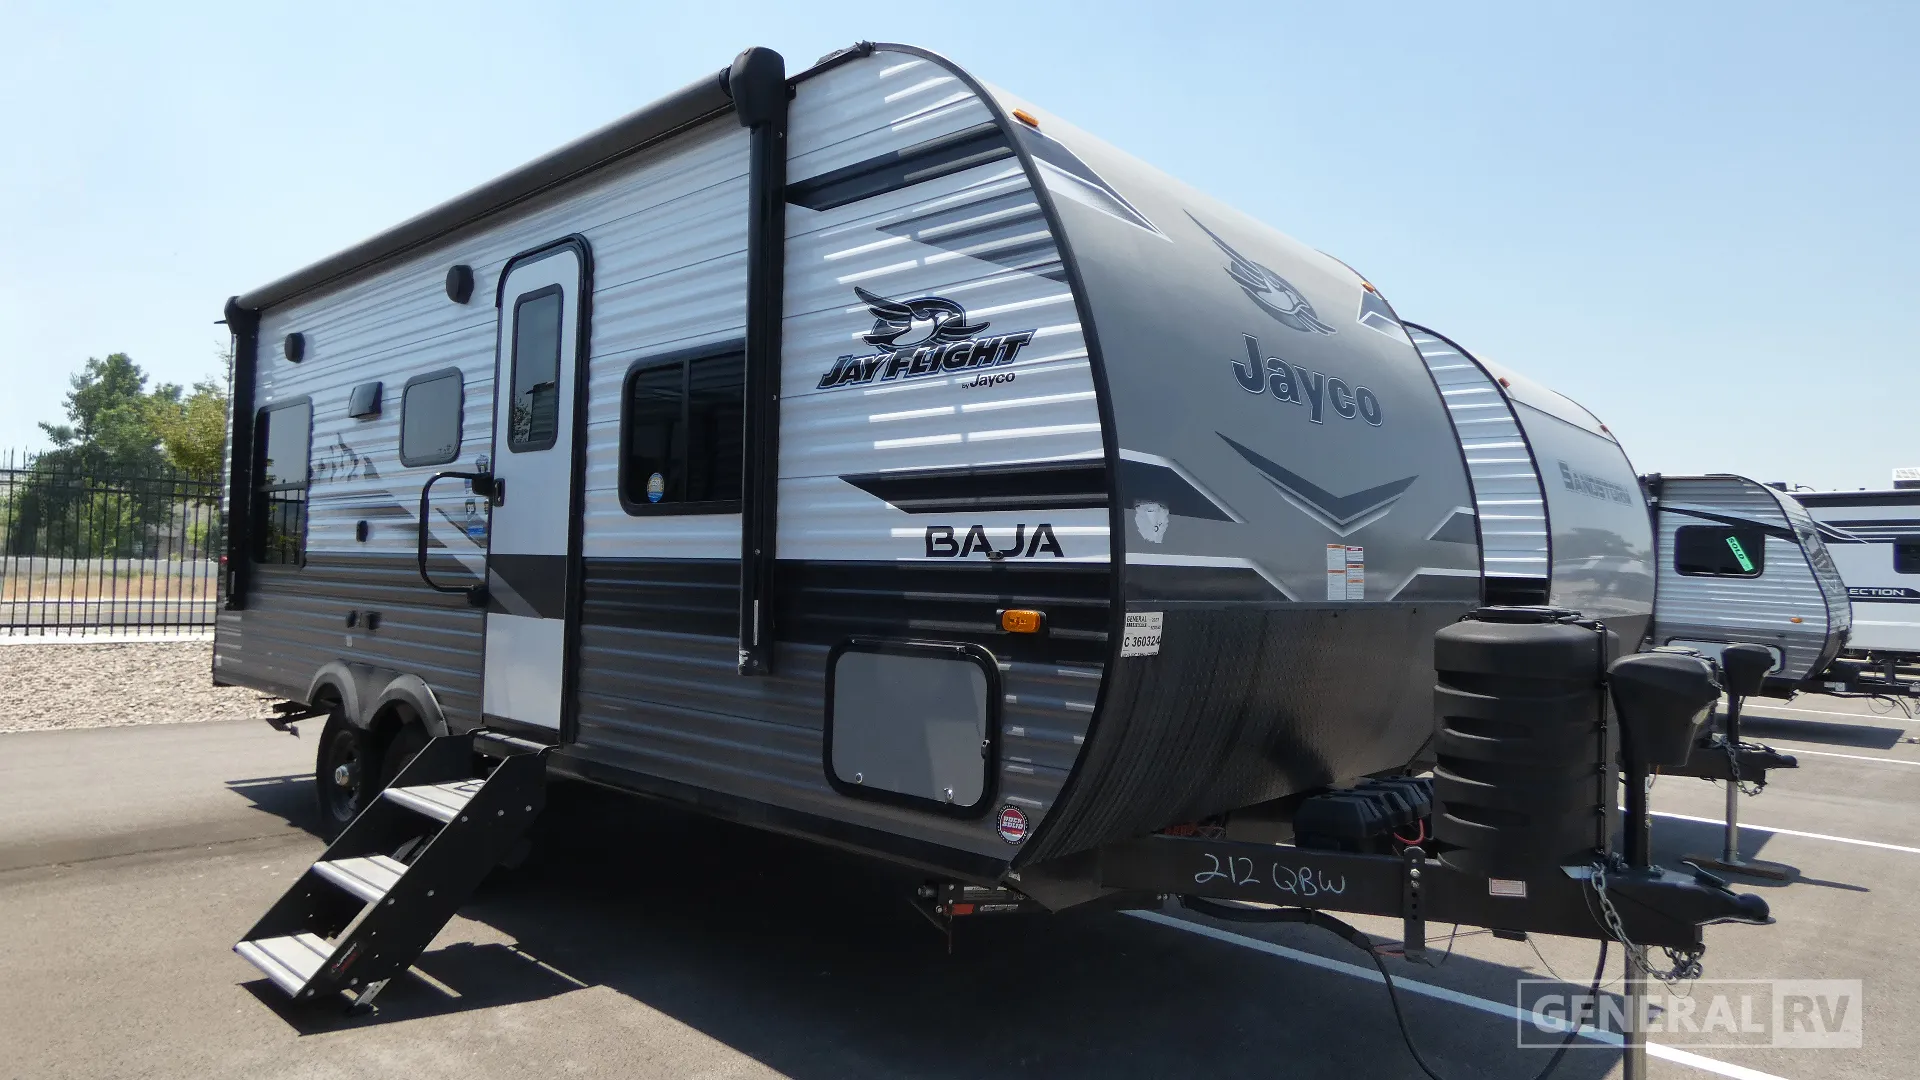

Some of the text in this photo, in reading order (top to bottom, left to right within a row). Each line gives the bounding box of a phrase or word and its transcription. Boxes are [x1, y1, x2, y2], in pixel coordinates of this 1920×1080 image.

[816, 329, 1038, 389] JAY FLIGHT
[969, 371, 1015, 388] Jayco
[1230, 332, 1383, 427] Jayco
[925, 523, 1065, 558] BAJA
[1728, 537, 1745, 560] SOLD
[1848, 588, 1905, 596] ECTION
[1124, 636, 1161, 647] C 360324
[1194, 853, 1261, 886] 212
